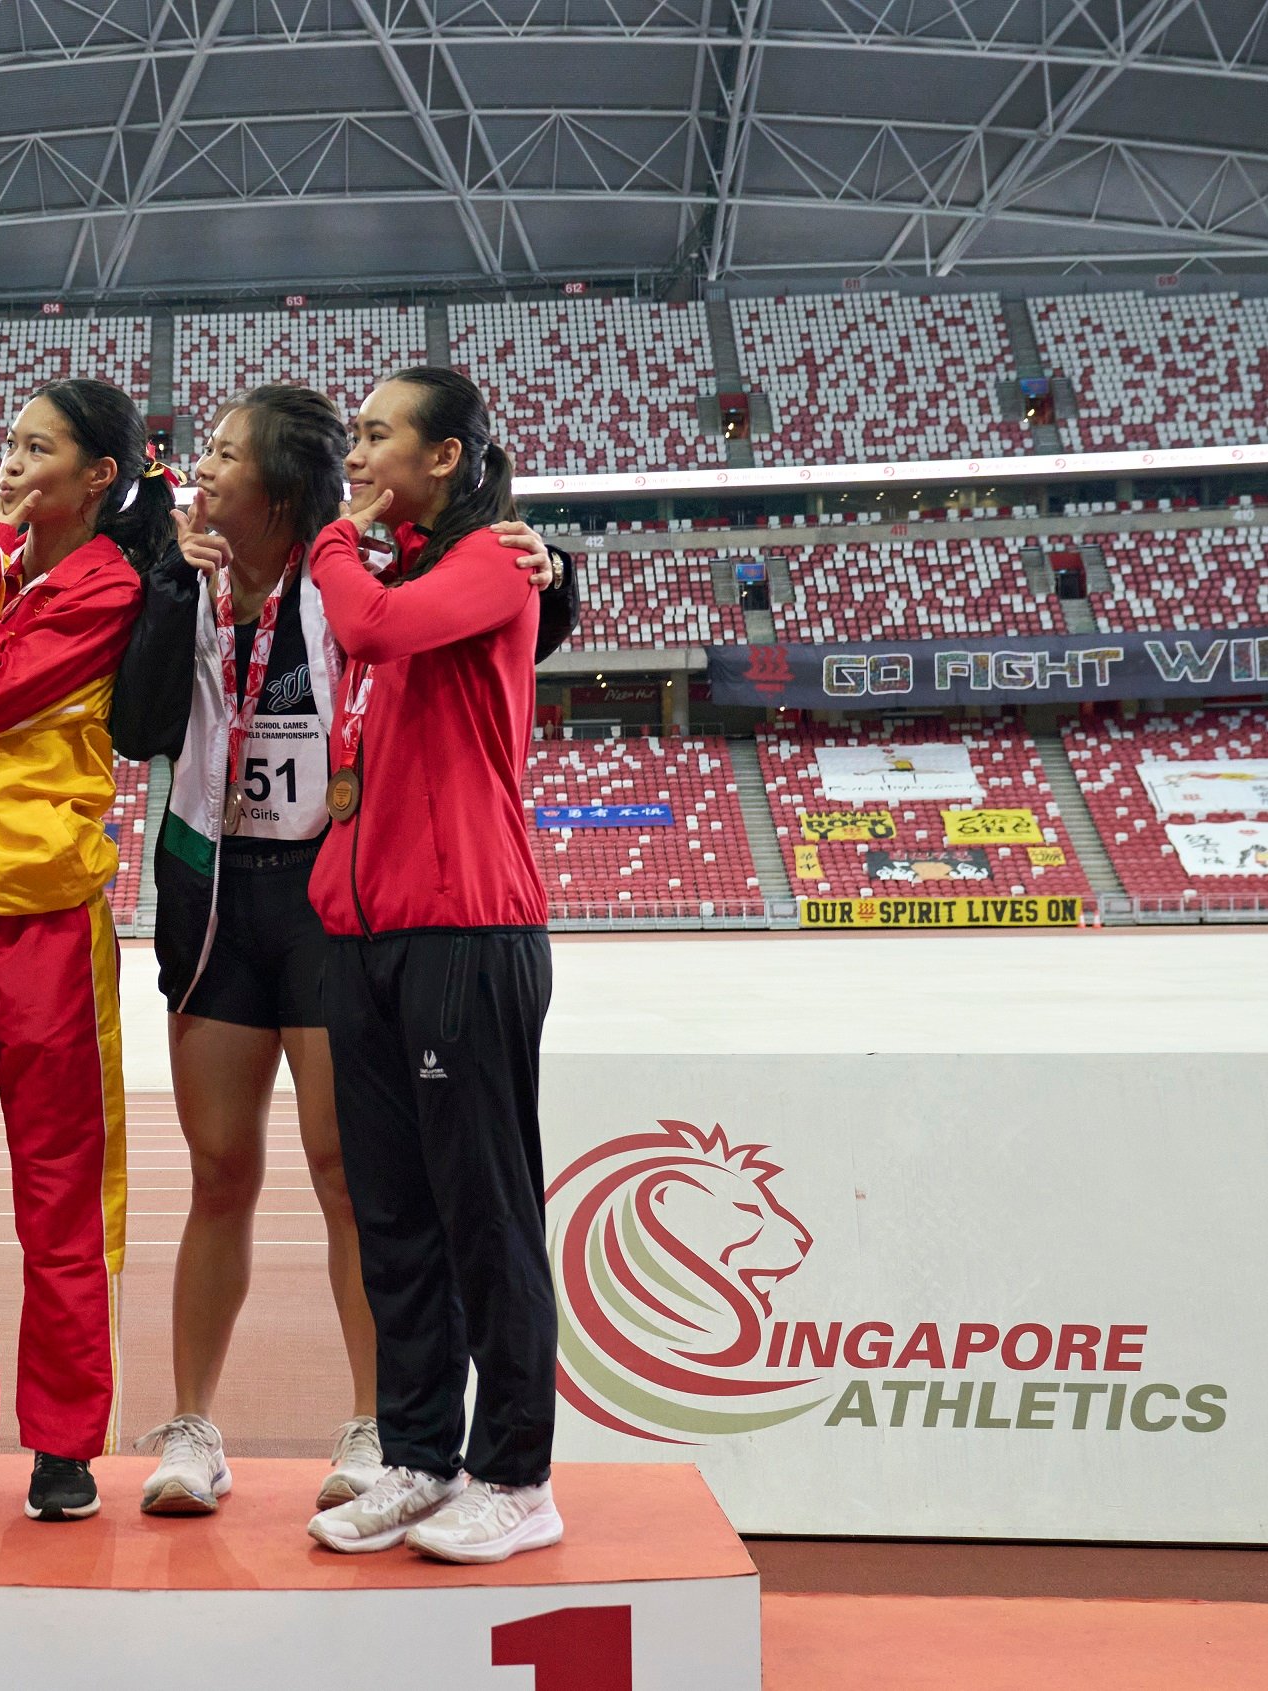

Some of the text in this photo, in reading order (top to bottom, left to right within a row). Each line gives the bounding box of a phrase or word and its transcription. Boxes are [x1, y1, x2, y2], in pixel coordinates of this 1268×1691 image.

[566, 283, 583, 293] 612
[286, 296, 302, 306] 613
[43, 304, 60, 313] 614
[585, 536, 605, 548] 412
[822, 653, 914, 696] GO
[934, 647, 1125, 691] FIGHT
[636, 688, 656, 699] Hut
[254, 721, 282, 730] SCHOOL
[282, 721, 309, 730] GAMES
[261, 731, 320, 740] CHAMPIONSHIPS
[244, 757, 298, 803] 51
[250, 808, 281, 821] Girls
[806, 899, 1077, 924] OUR SPIRIT LIVES ON
[824, 1379, 1229, 1433] ATHLETICS
